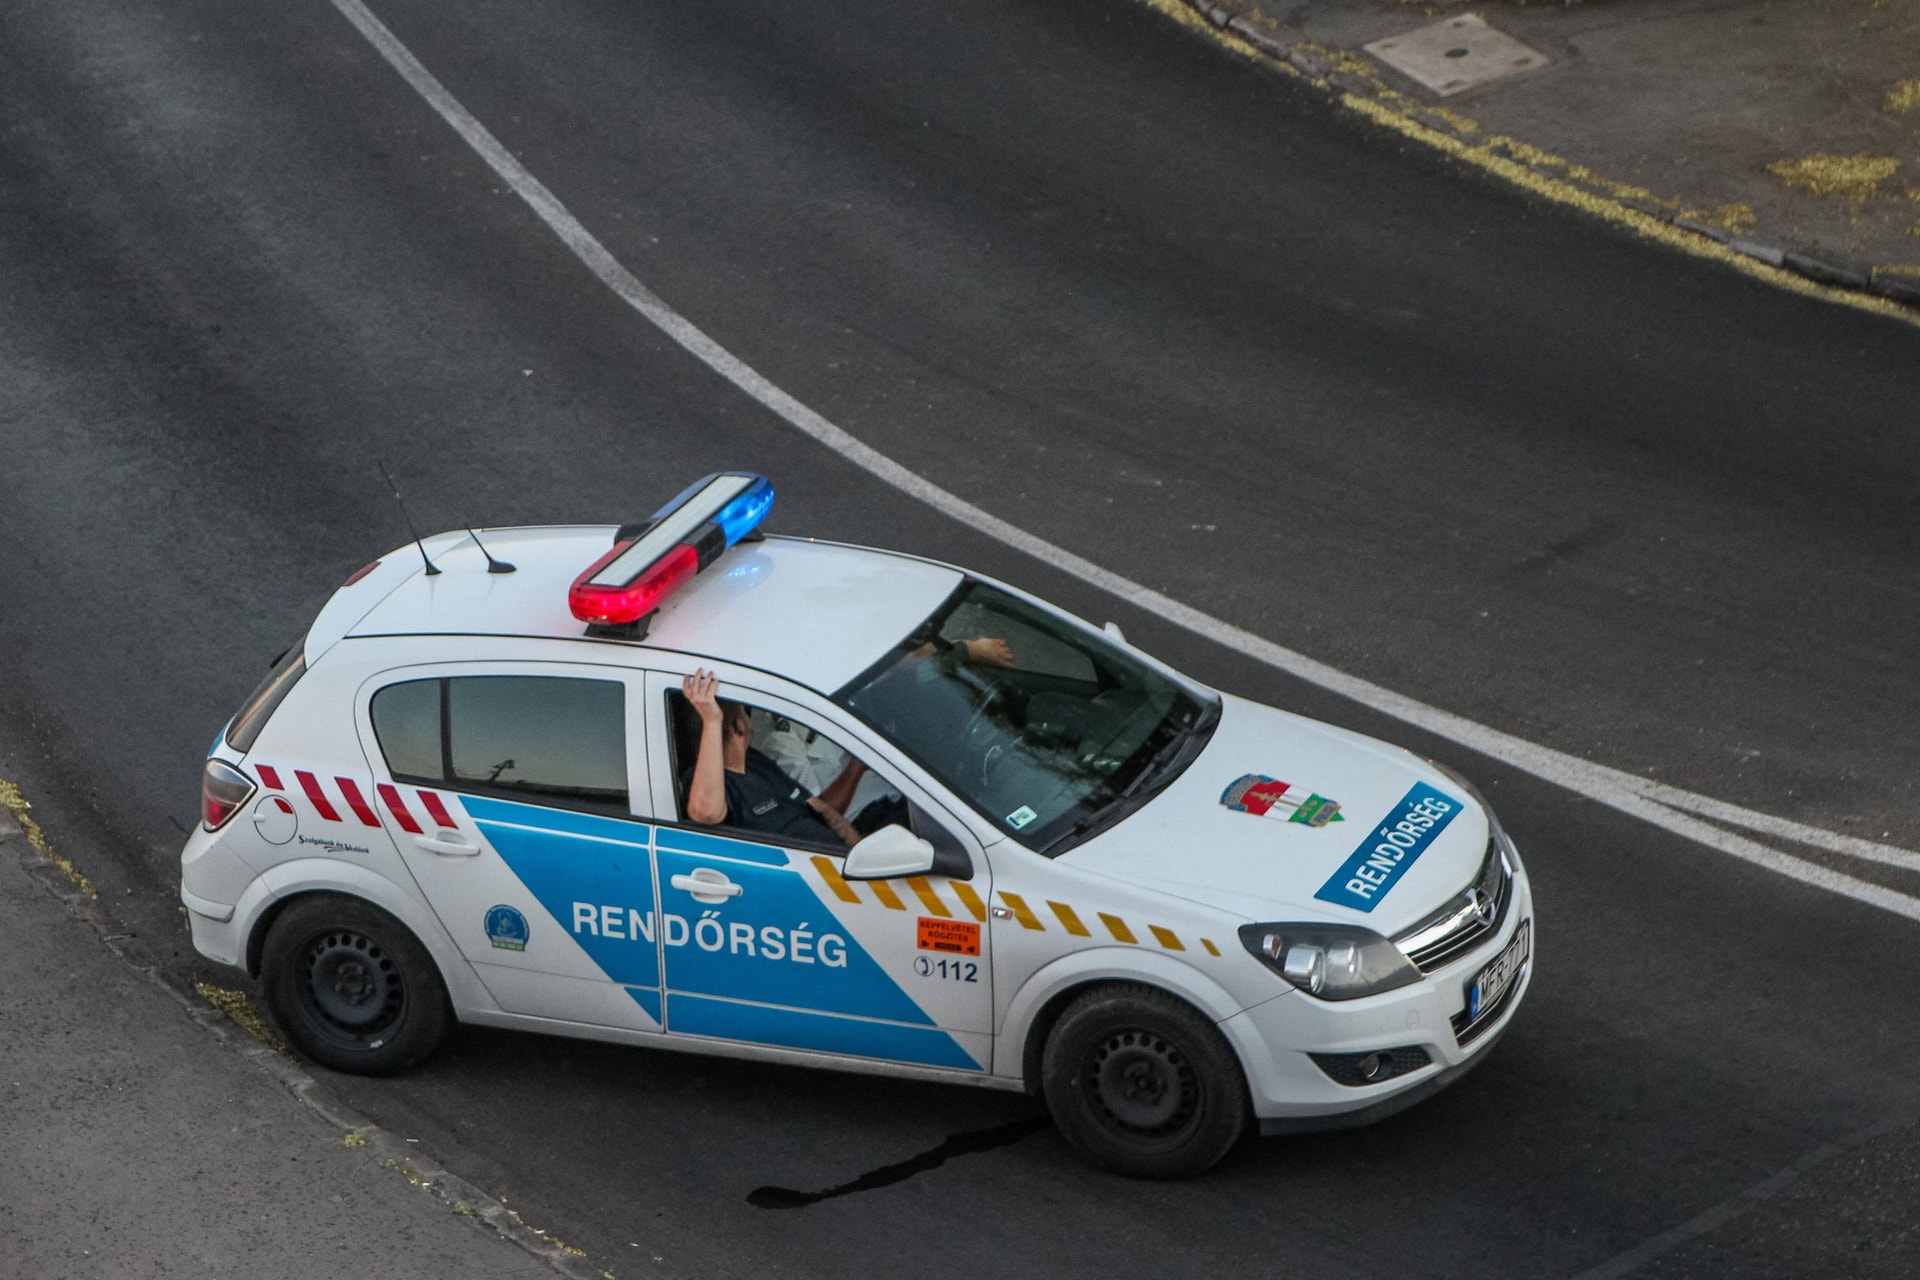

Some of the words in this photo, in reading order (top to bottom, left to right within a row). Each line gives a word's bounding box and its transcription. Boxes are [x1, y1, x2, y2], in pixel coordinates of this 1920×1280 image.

[1345, 797, 1451, 899] RENDŐRSÉG
[572, 901, 848, 968] RENDŐRSÉG
[937, 959, 978, 983] 112
